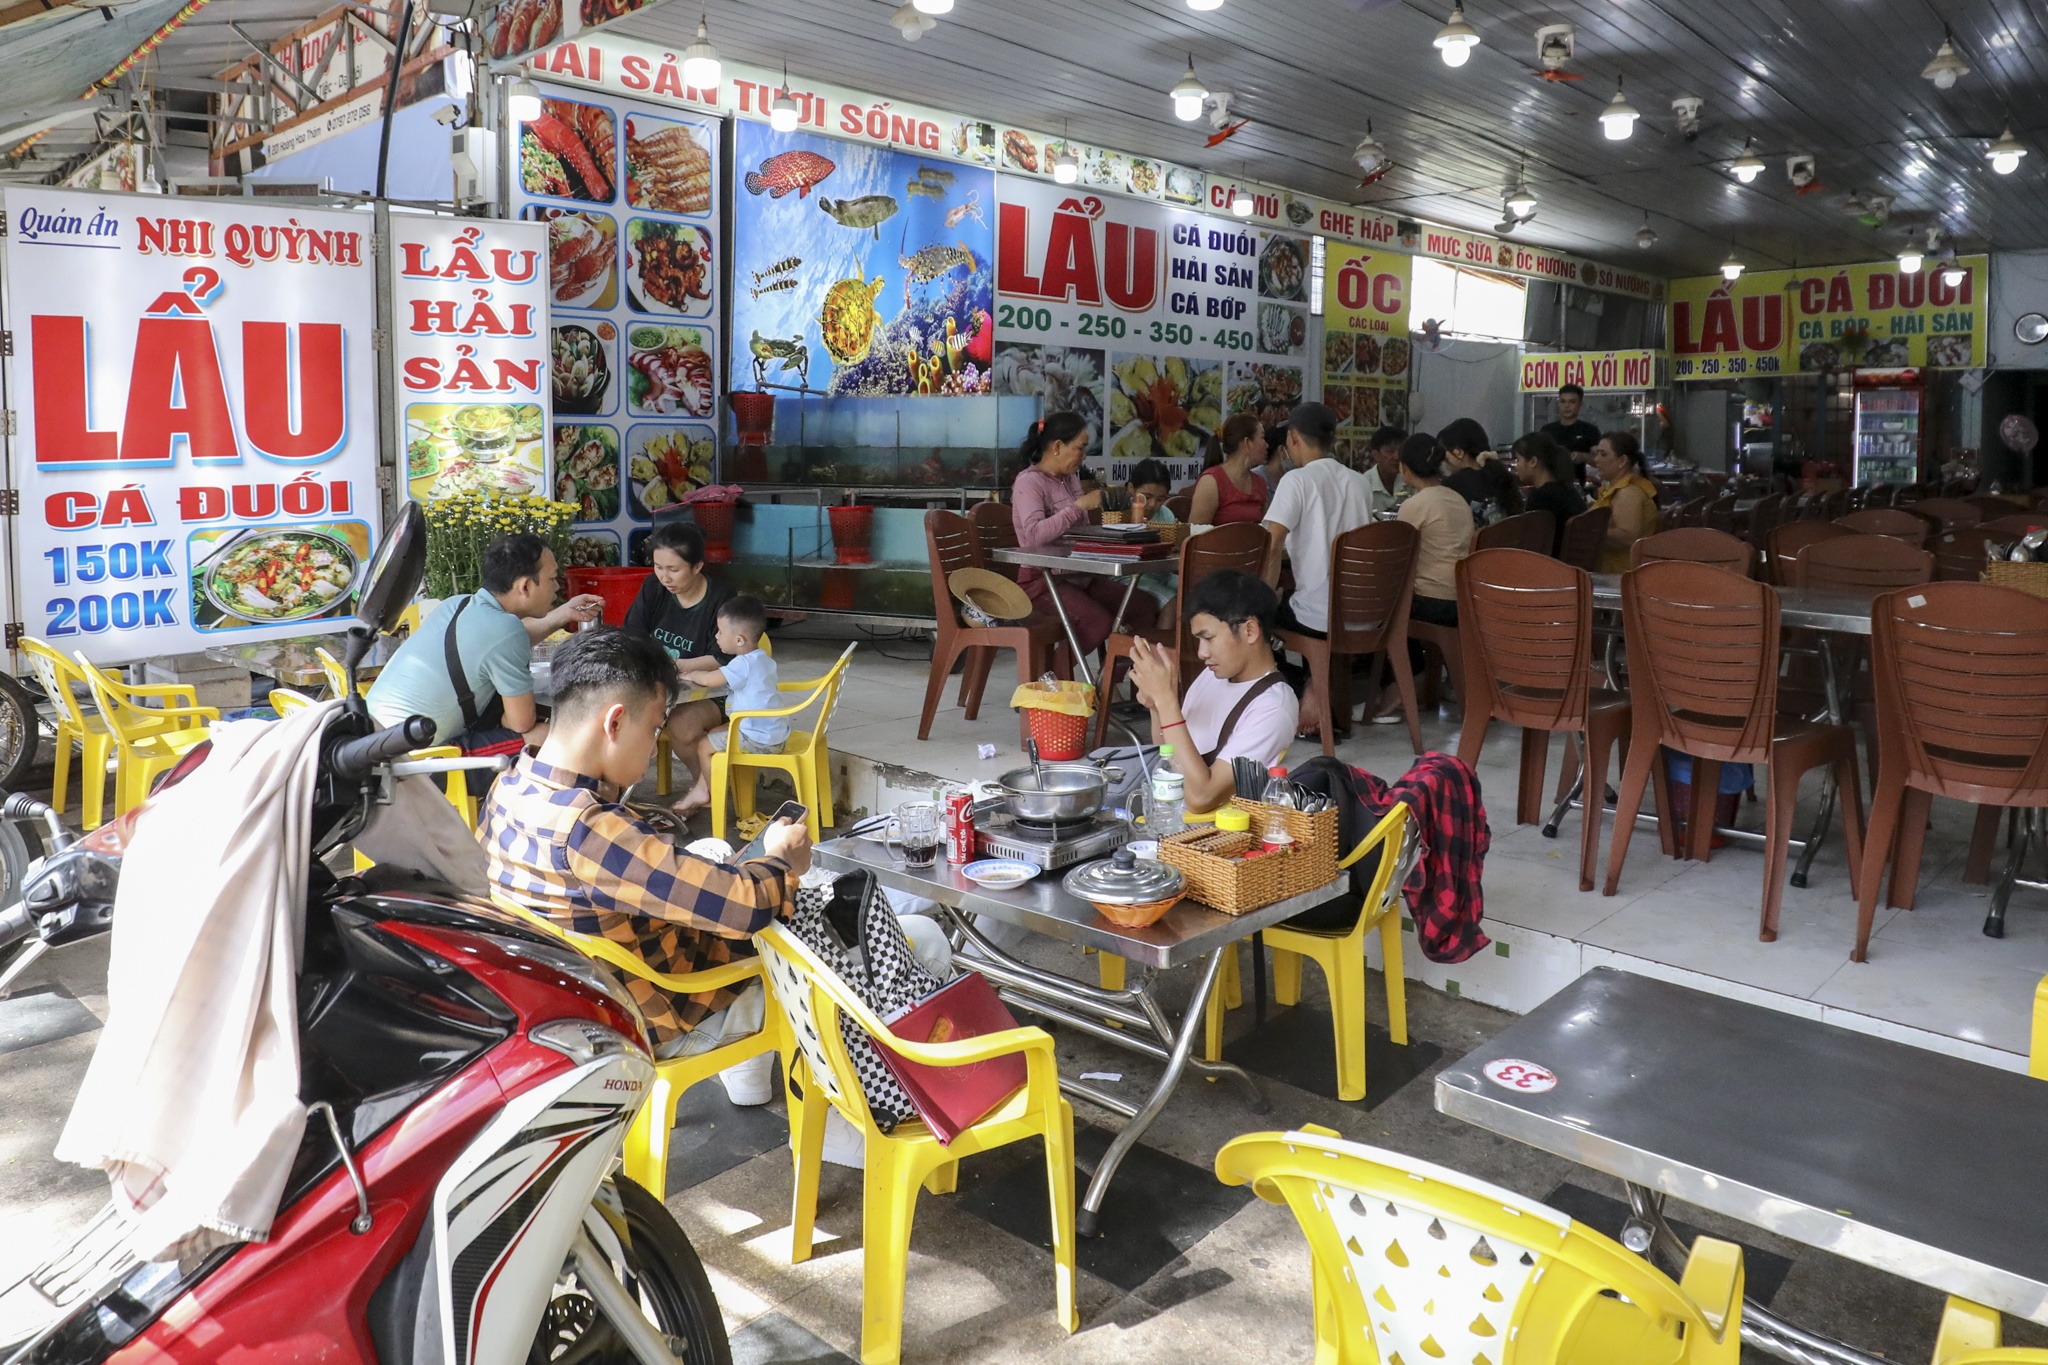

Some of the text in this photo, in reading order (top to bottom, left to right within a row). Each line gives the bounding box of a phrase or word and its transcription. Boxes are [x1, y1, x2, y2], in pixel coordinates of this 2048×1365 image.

[840, 102, 940, 151] SỐNG
[20, 206, 119, 239] Quán Ăn
[136, 217, 362, 267] NHI QUỲNH
[1173, 223, 1256, 257] CÁ ĐUỐI
[1320, 210, 1395, 243] GHẸ HẤP
[401, 227, 539, 283] LẨU
[998, 197, 1158, 312] LẨU
[1427, 233, 1493, 263] MỰC SỮA
[1516, 246, 1576, 280] ỐC HƯƠNG
[1172, 256, 1253, 289] HẢI SẢN
[1337, 255, 1403, 314] ỐC
[1800, 270, 1853, 315] CÁ
[409, 289, 535, 337] HẢI
[998, 304, 1052, 333] 200
[1078, 313, 1127, 340] 250
[1149, 321, 1194, 346] 350
[1213, 329, 1254, 351] 450
[1171, 292, 1247, 321] CÁ BỚP
[31, 266, 347, 467] LẨU
[403, 344, 543, 393] SẢN
[1524, 351, 1651, 388] CƠM GÀ XỐI MỠ
[1676, 360, 1693, 374] 200
[1702, 359, 1720, 374] 250
[1728, 357, 1747, 373] 350
[44, 471, 352, 530] CÁ ĐUỐI
[44, 538, 178, 586] 150K
[45, 587, 179, 637] 200K
[654, 627, 694, 652] GUCCI
[603, 1079, 643, 1092] HONDA
[1496, 1065, 1542, 1089] 33
